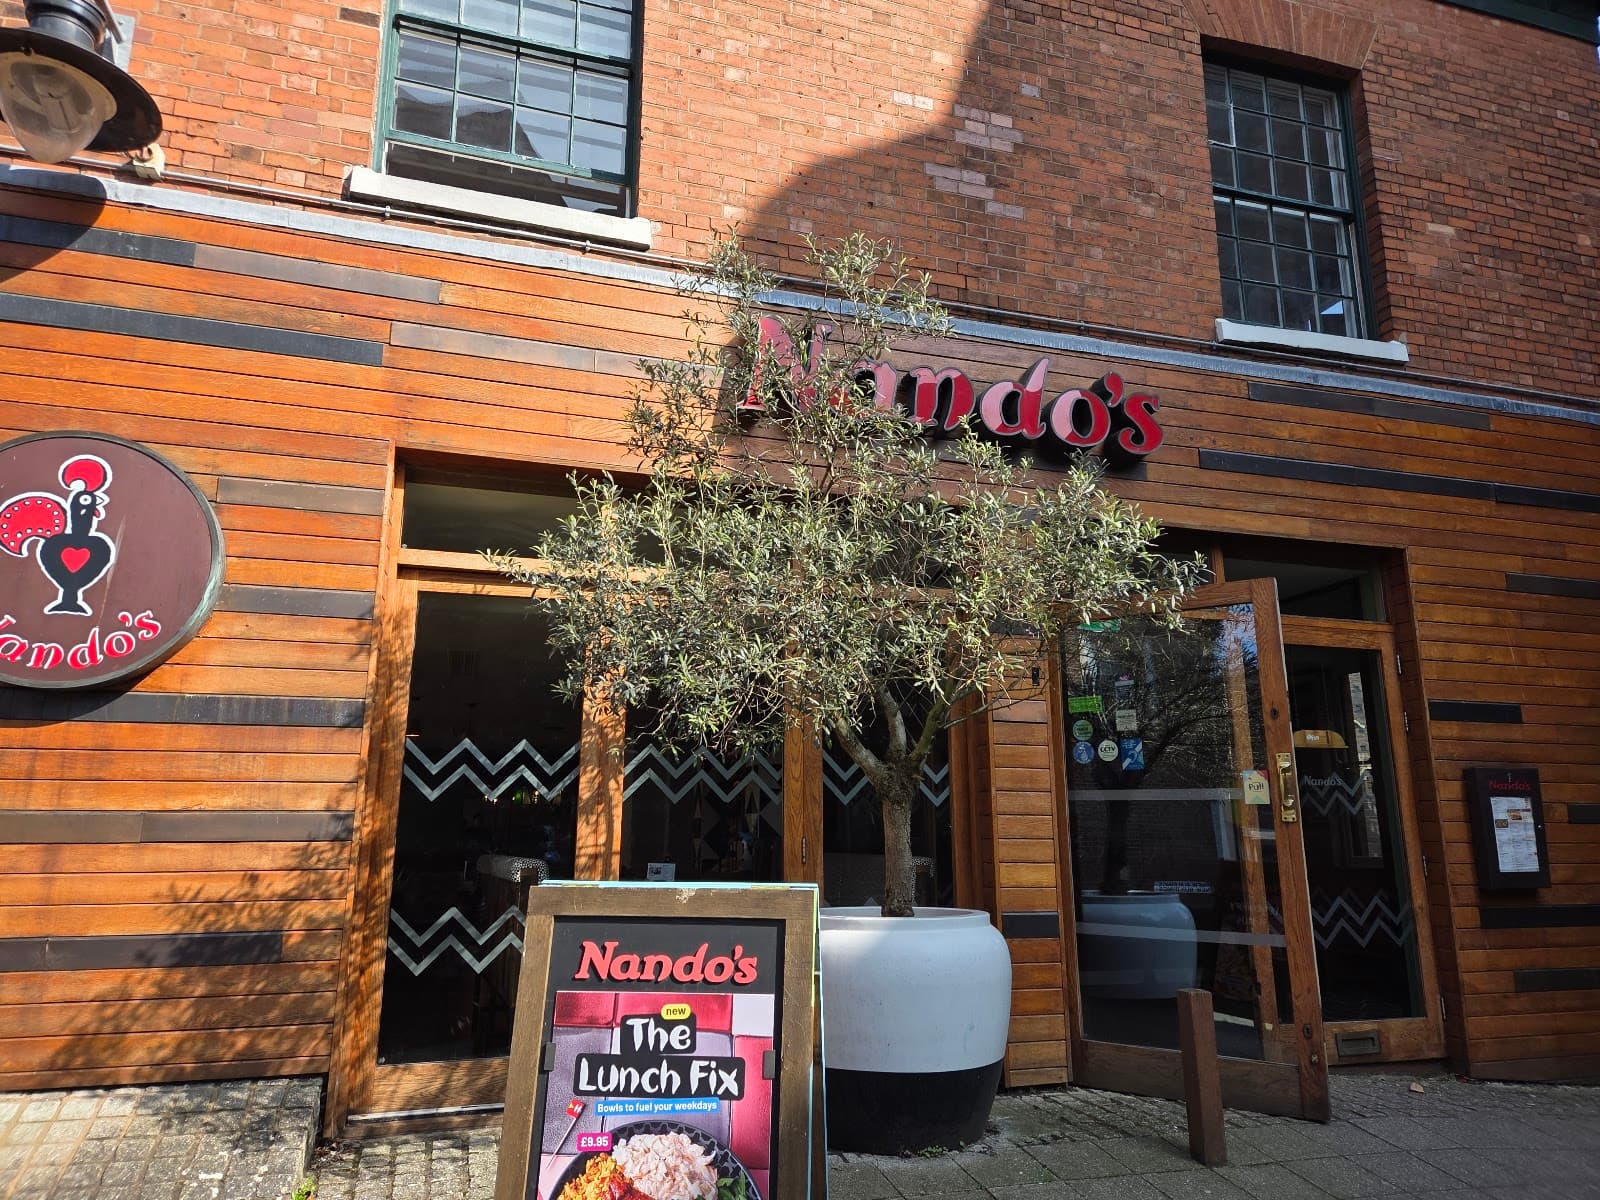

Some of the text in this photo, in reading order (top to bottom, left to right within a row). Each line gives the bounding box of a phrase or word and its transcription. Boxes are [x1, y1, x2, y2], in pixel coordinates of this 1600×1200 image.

[737, 316, 1163, 455] Nando's
[1304, 775, 1342, 786] Nando's
[1488, 780, 1532, 791] Nando's
[573, 941, 758, 984] Nando's
[666, 1007, 687, 1016] new
[626, 1017, 691, 1052] The
[578, 1057, 739, 1097] Lunch Fix
[597, 1101, 717, 1113] Bowls to fuel your weekdays
[580, 1136, 609, 1148] £9.95
